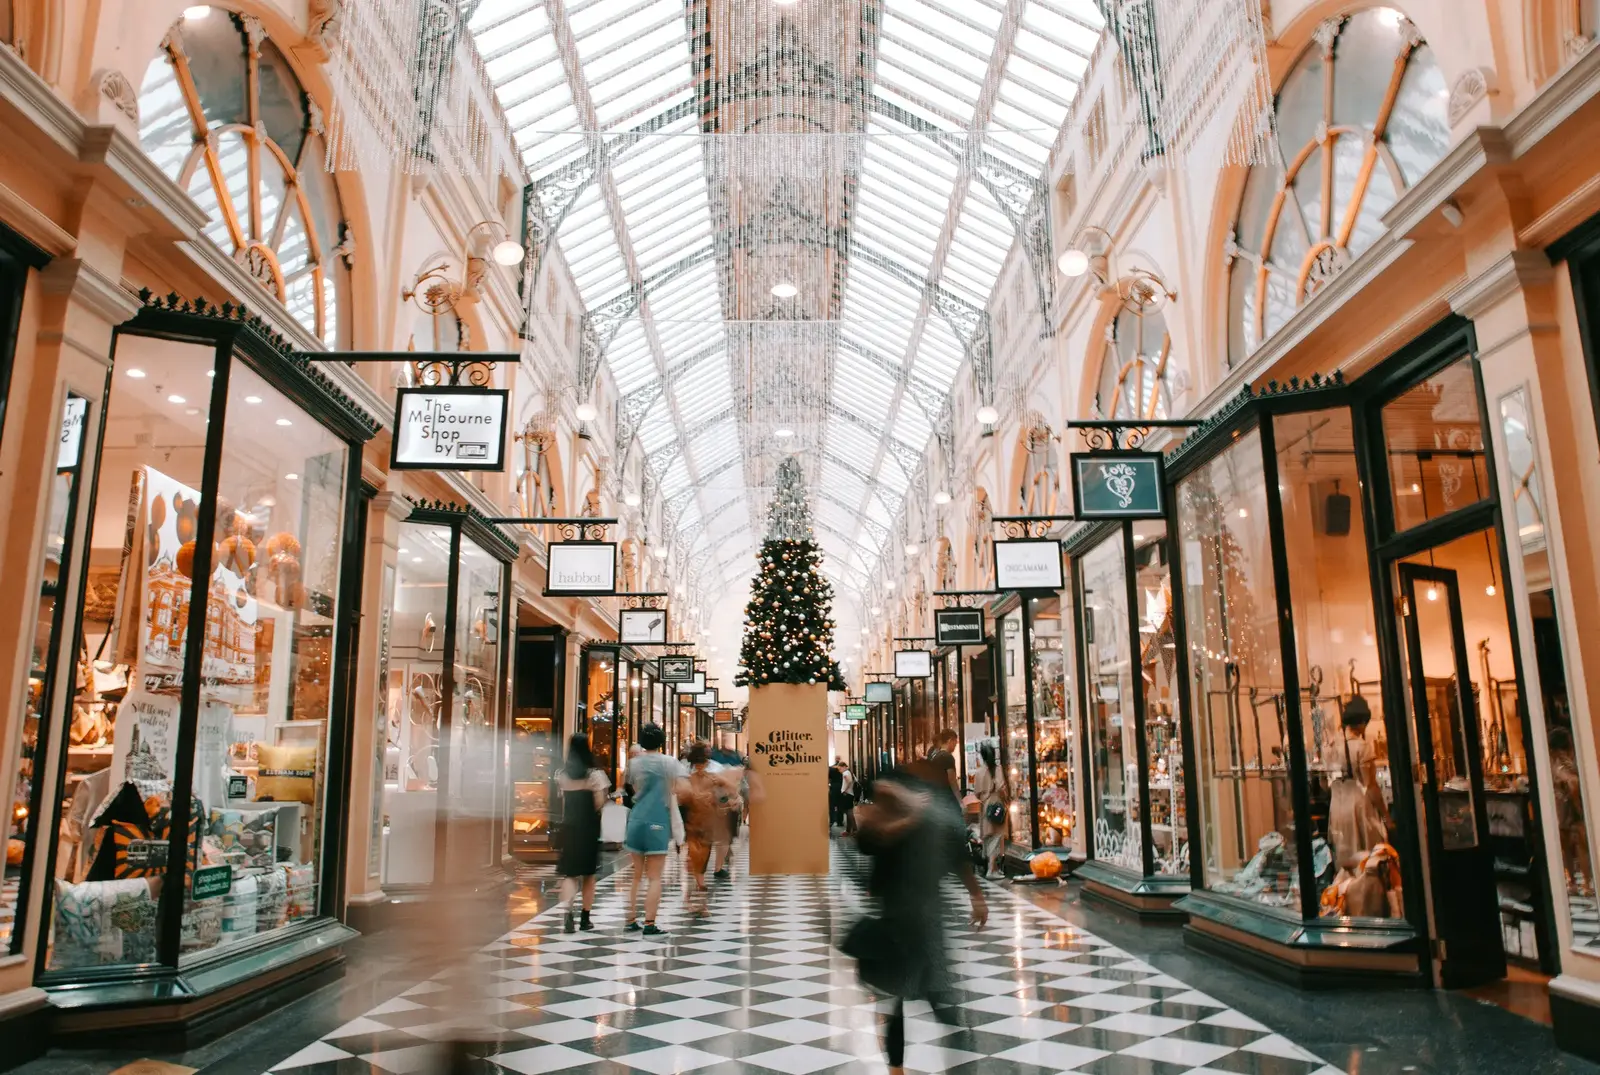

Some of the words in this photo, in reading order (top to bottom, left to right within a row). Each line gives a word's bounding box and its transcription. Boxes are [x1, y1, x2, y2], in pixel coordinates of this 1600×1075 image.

[425, 399, 452, 412] The
[408, 410, 492, 424] Melbourne
[421, 425, 460, 443] Shop
[435, 443, 454, 456] by
[940, 623, 979, 632] WESTMINSTER
[755, 742, 803, 754] Sparkle
